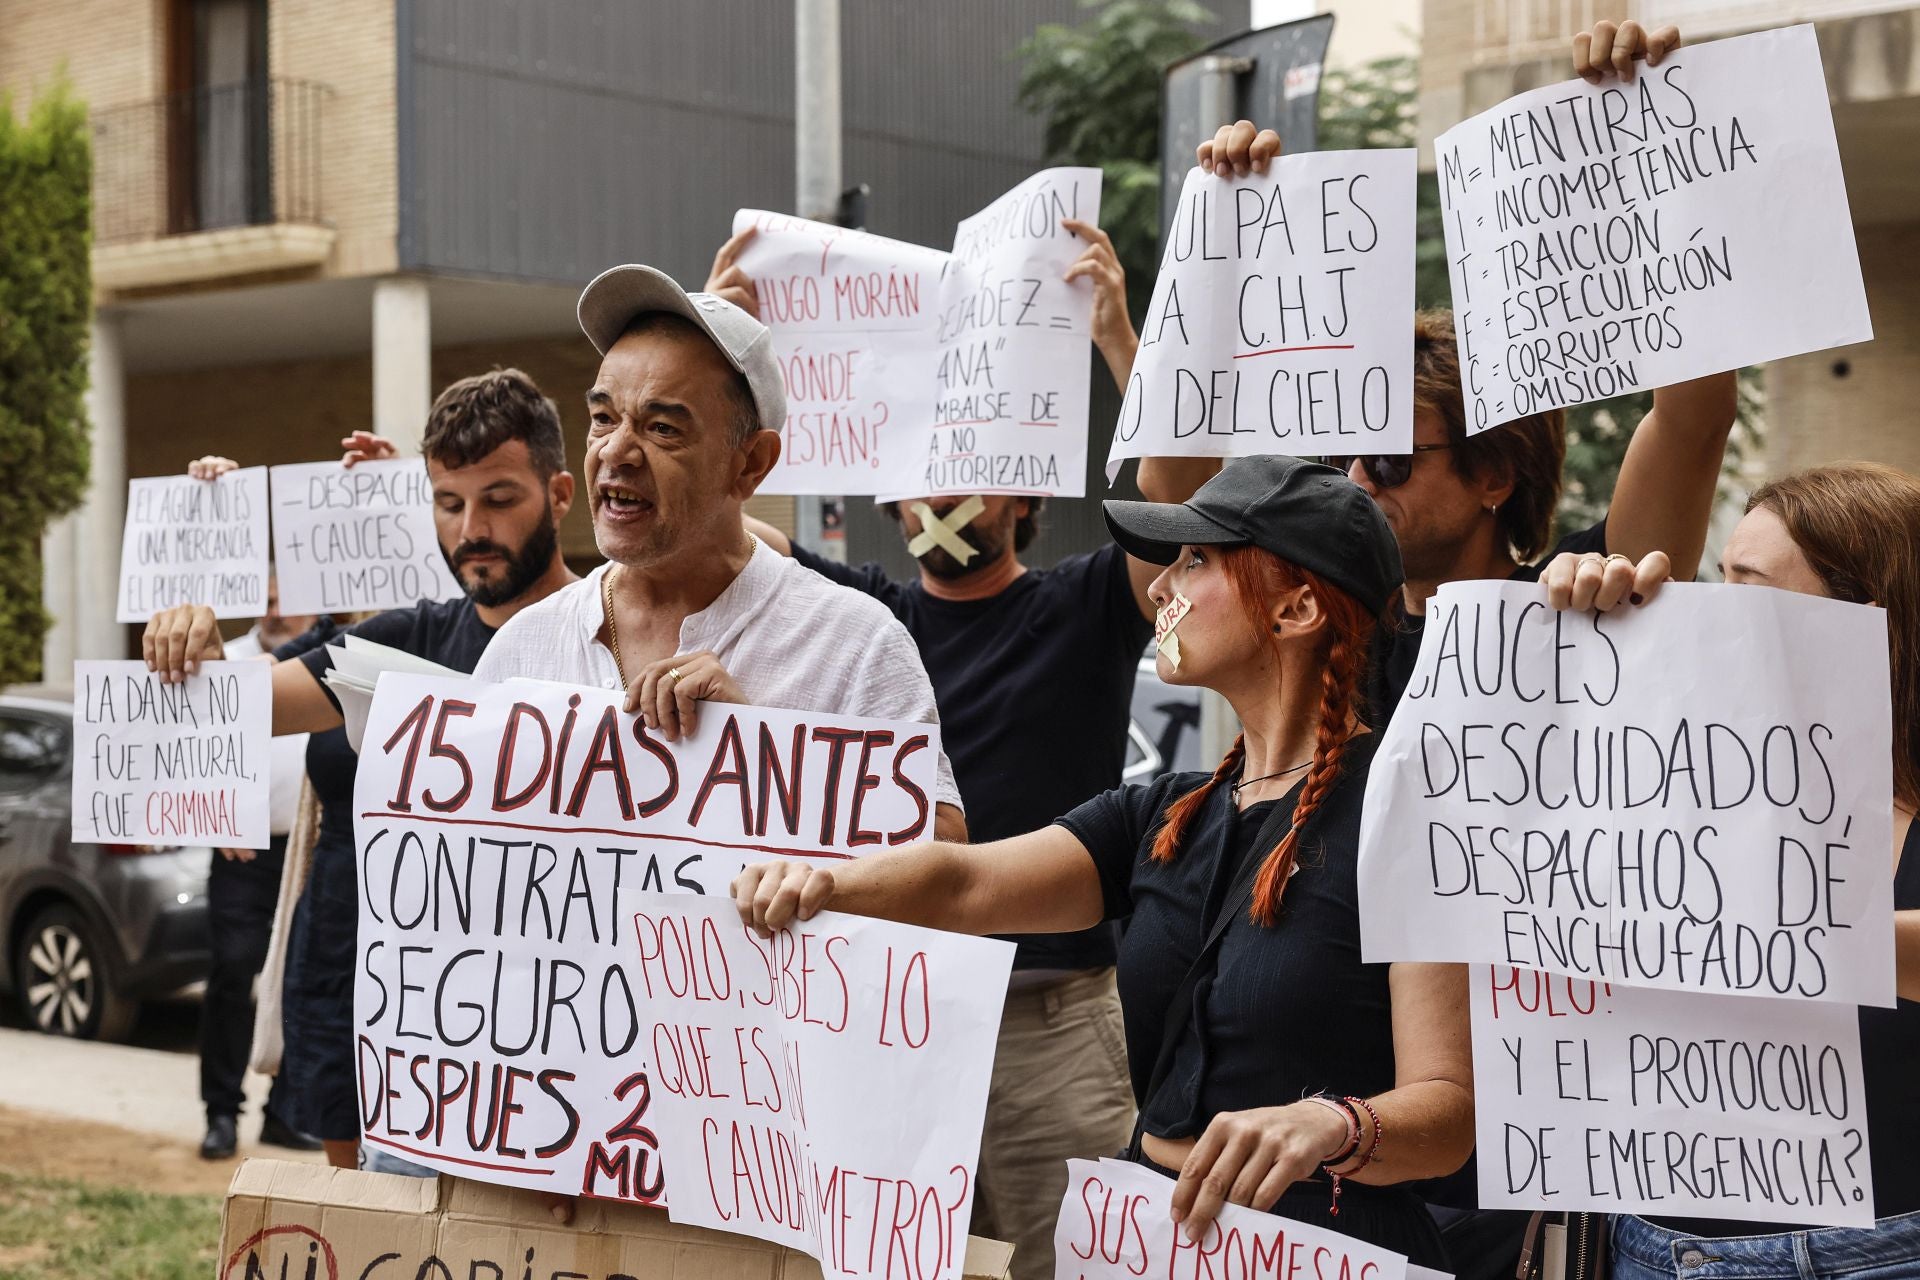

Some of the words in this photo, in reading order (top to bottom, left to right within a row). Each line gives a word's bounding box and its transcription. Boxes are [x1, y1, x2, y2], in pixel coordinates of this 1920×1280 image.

[1490, 66, 1697, 178] MENTIRAS
[1495, 117, 1757, 233] INCOMPETENCIA
[1161, 184, 1294, 270] ULPA
[1322, 174, 1377, 253] ES
[1495, 204, 1660, 289] TRAICIÓN
[752, 275, 819, 323] HUGO
[834, 265, 919, 322] MORÁN
[1143, 279, 1188, 347] LA
[1503, 227, 1732, 340] ESPECULACIÓN
[1507, 306, 1682, 383] CORRUPTOS
[936, 392, 1012, 425] MBALSE
[1032, 392, 1059, 422] DE
[1175, 368, 1256, 438] DEL
[1269, 366, 1389, 438] CIELO
[1514, 360, 1638, 415] OMISIÓN
[787, 401, 888, 469] ESTÁN?
[951, 427, 975, 454] NO
[135, 487, 153, 524] EL
[160, 484, 202, 523] AGUA
[210, 481, 228, 523] NO
[235, 477, 250, 521] ES
[308, 470, 435, 510] DESPACHO
[925, 454, 1060, 491] AUTORIZADA
[138, 529, 168, 565] UNA
[312, 514, 414, 564] CAUCES
[128, 574, 147, 613] EL
[321, 553, 441, 608] LIMPIOS
[86, 675, 115, 723] LA
[127, 675, 198, 729] DANA
[209, 674, 239, 725] NO
[154, 732, 256, 783] NATURAL,
[383, 694, 476, 813] 15
[688, 714, 929, 847] ANTES
[1421, 718, 1853, 838] DESCUIDADOS,
[147, 789, 243, 837] CRIMINAL
[1429, 822, 1723, 926] DESPACHOS
[1777, 836, 1854, 930] DE
[364, 940, 639, 1059] SEGURO
[879, 946, 931, 1050] LO
[358, 1034, 580, 1160] DESPUES
[653, 1022, 730, 1099] QUE
[735, 1027, 782, 1112] ES
[1501, 1037, 1523, 1096] Y
[1555, 1038, 1609, 1102] EL
[1630, 1033, 1848, 1121] PROTOCOLO
[1504, 1123, 1559, 1197] DE
[1586, 1128, 1864, 1207] EMERGENCIA?
[1071, 1176, 1150, 1276] SUS
